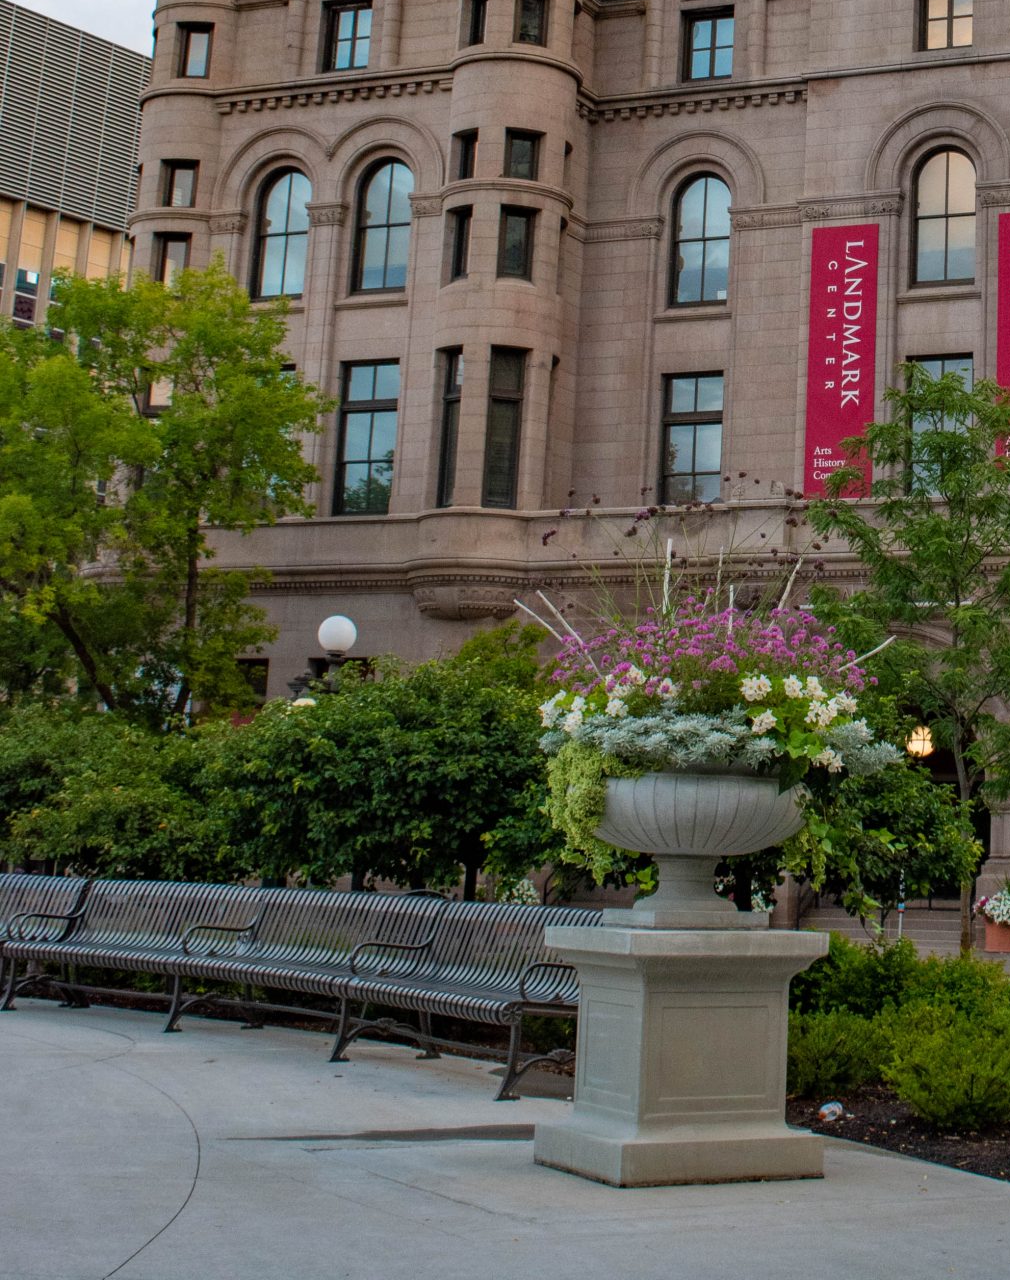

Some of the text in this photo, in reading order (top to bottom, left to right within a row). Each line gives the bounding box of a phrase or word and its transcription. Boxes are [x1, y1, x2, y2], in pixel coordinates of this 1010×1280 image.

[824, 260, 838, 390] CENTER
[840, 240, 869, 409] LANDMARK
[813, 446, 832, 455] Arts
[813, 458, 846, 468] History
